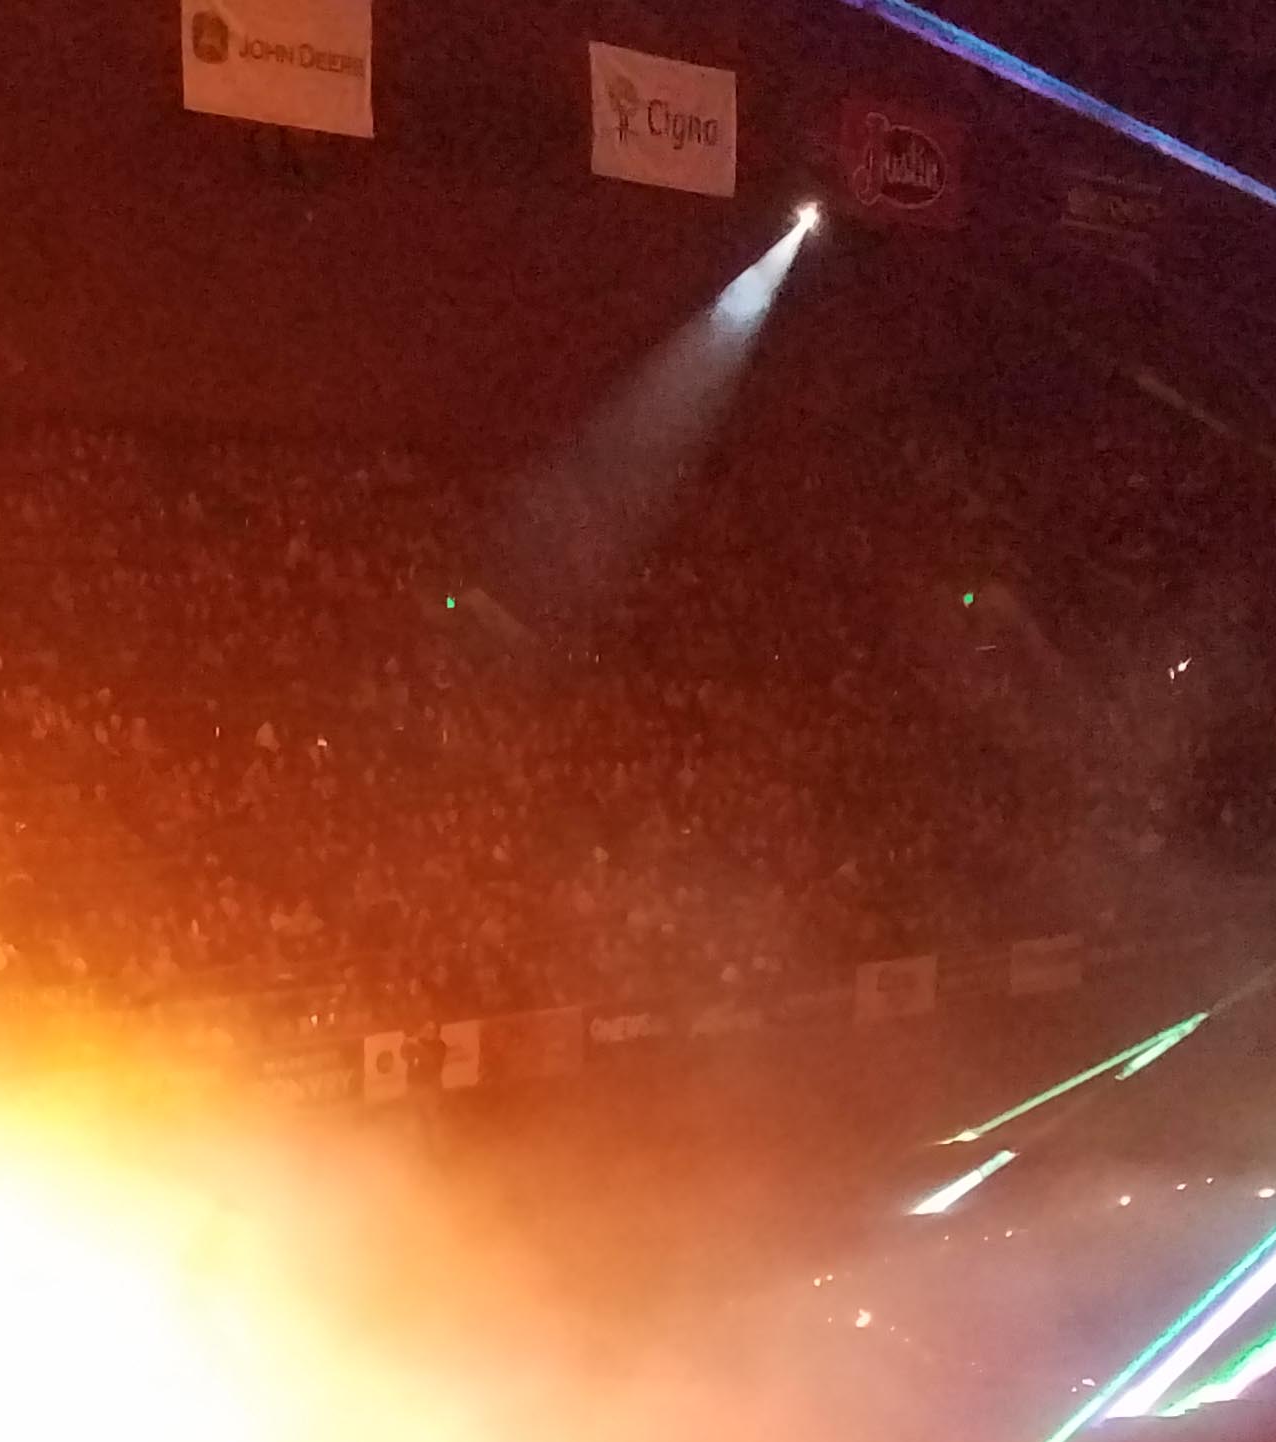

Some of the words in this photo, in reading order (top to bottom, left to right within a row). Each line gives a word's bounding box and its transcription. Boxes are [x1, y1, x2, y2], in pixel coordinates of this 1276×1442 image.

[238, 33, 293, 65] JOHN
[299, 43, 366, 79] DEERE
[647, 98, 719, 151] Cigna
